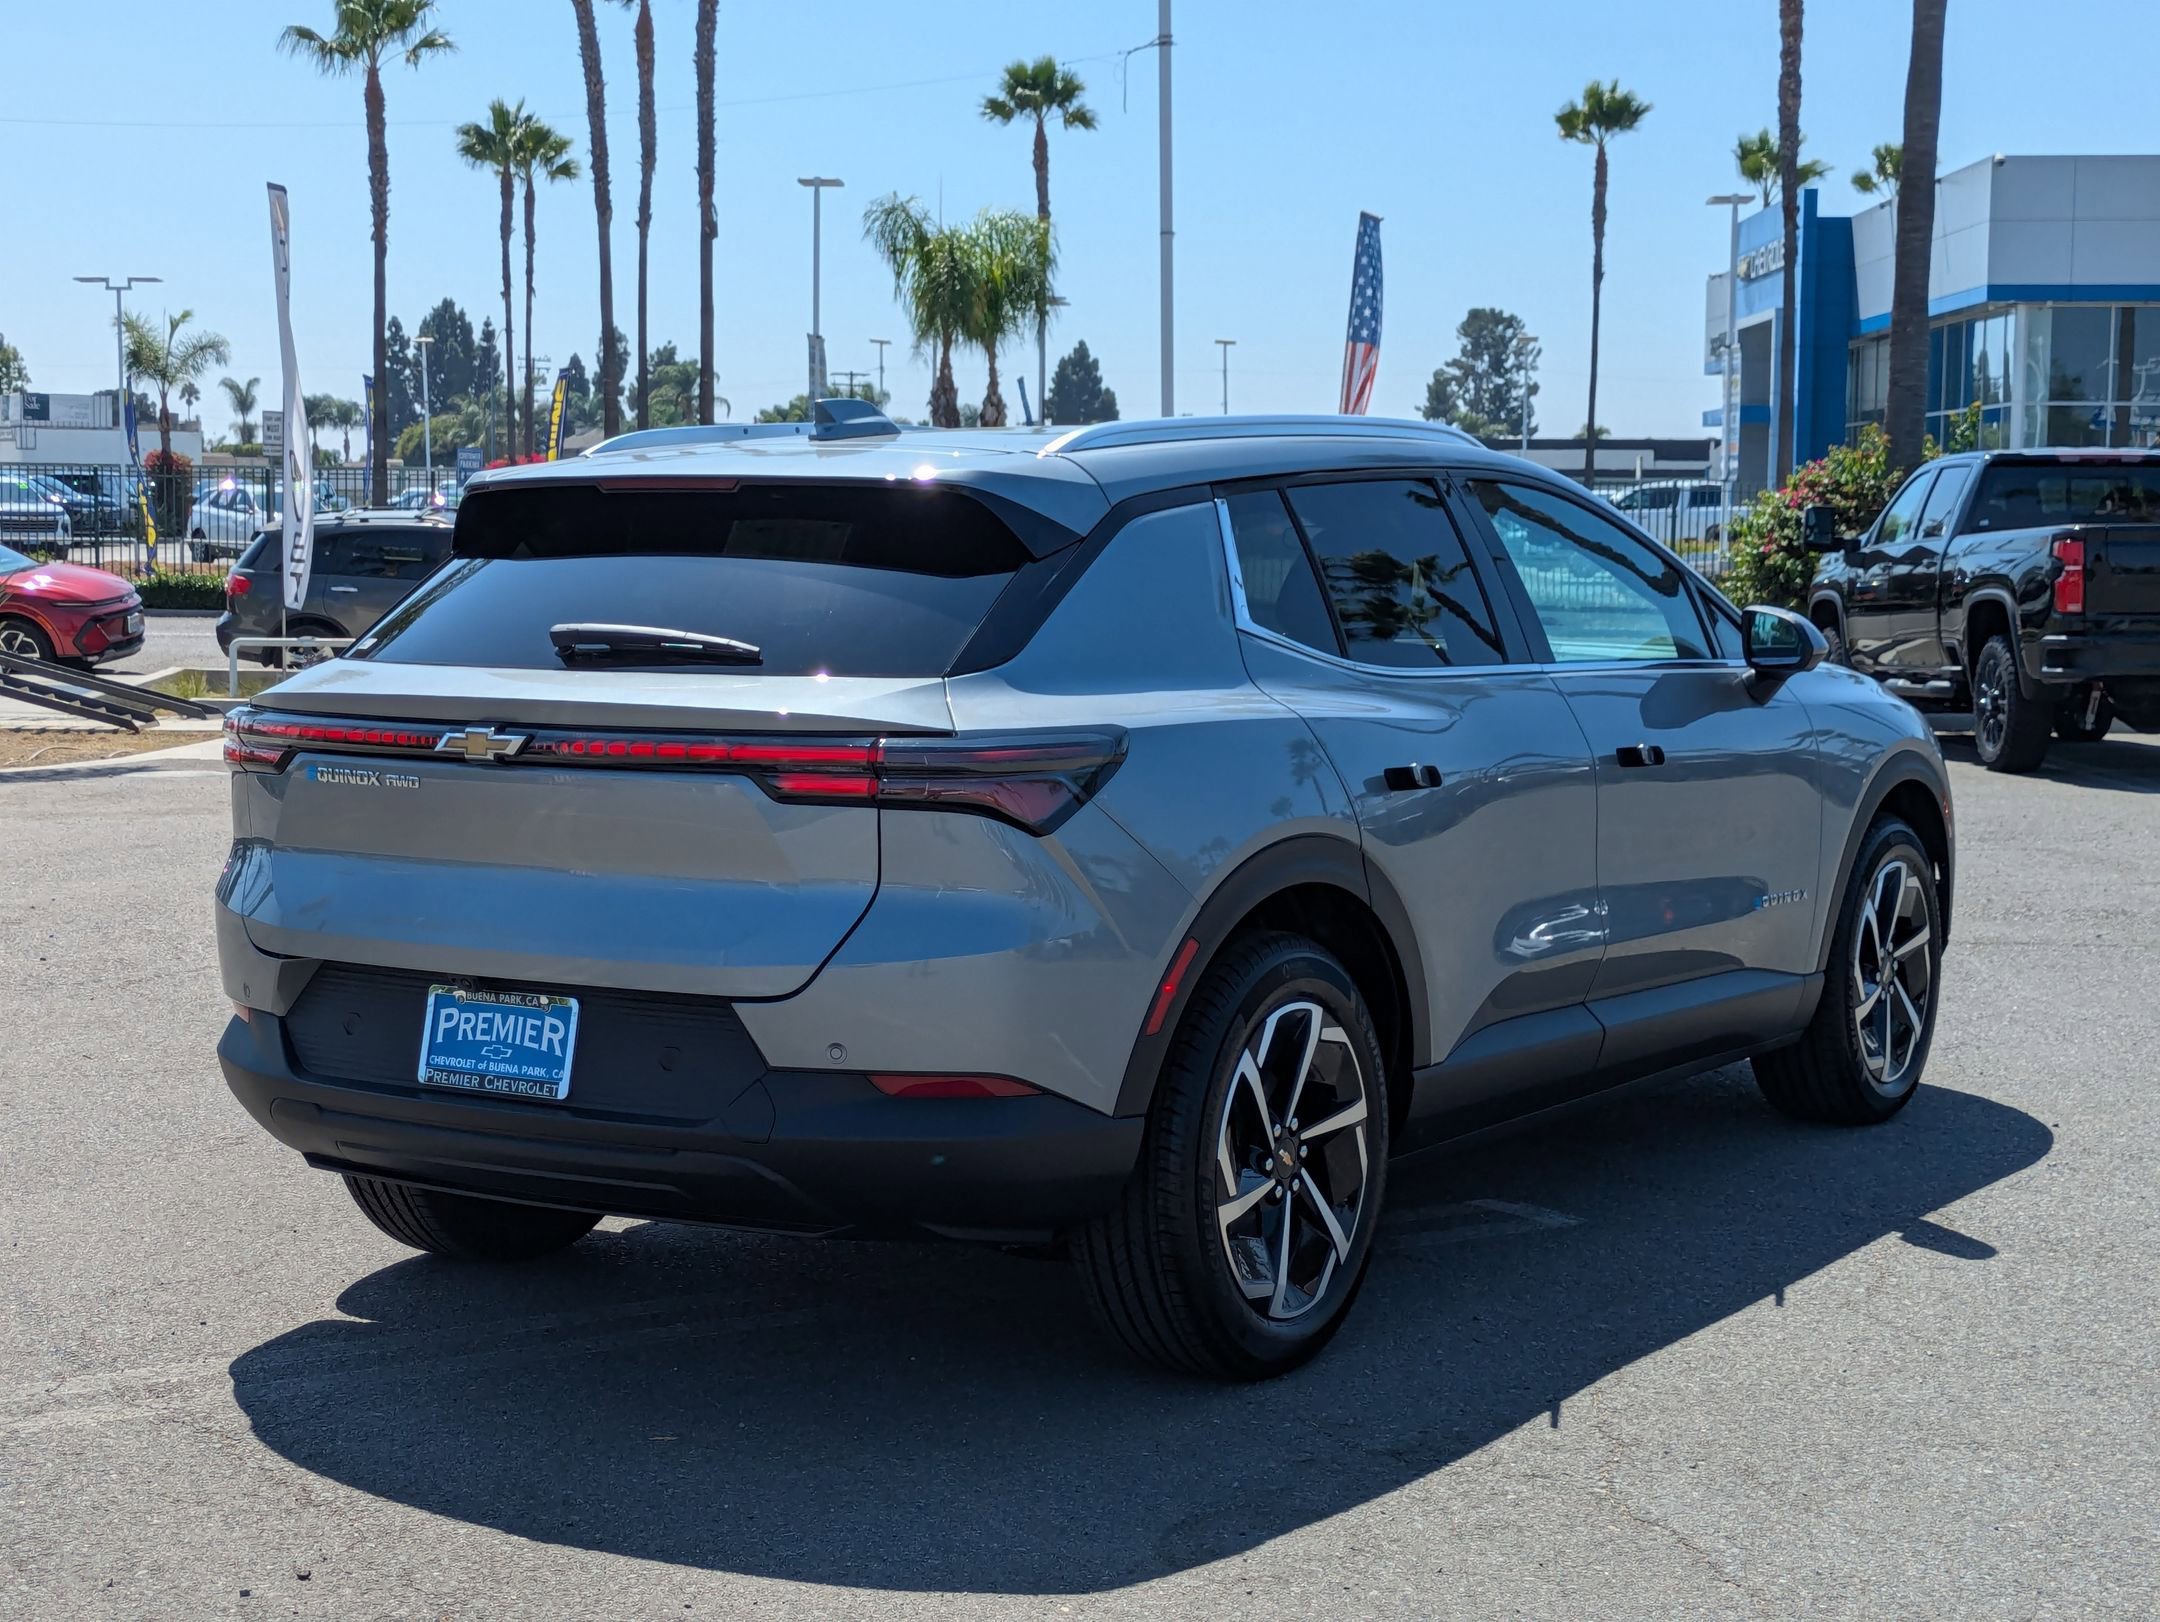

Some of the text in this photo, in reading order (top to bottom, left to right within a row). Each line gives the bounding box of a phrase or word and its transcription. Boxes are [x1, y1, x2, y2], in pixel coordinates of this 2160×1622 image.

[467, 991, 496, 1002] BUENA
[526, 996, 539, 1006] CA
[436, 1007, 565, 1057] PREMIER
[429, 1055, 476, 1069] CHEVROLET
[478, 1062, 487, 1070] of
[489, 1063, 519, 1074] BUENA
[425, 1069, 559, 1096] PREMIER CHEVROLET
